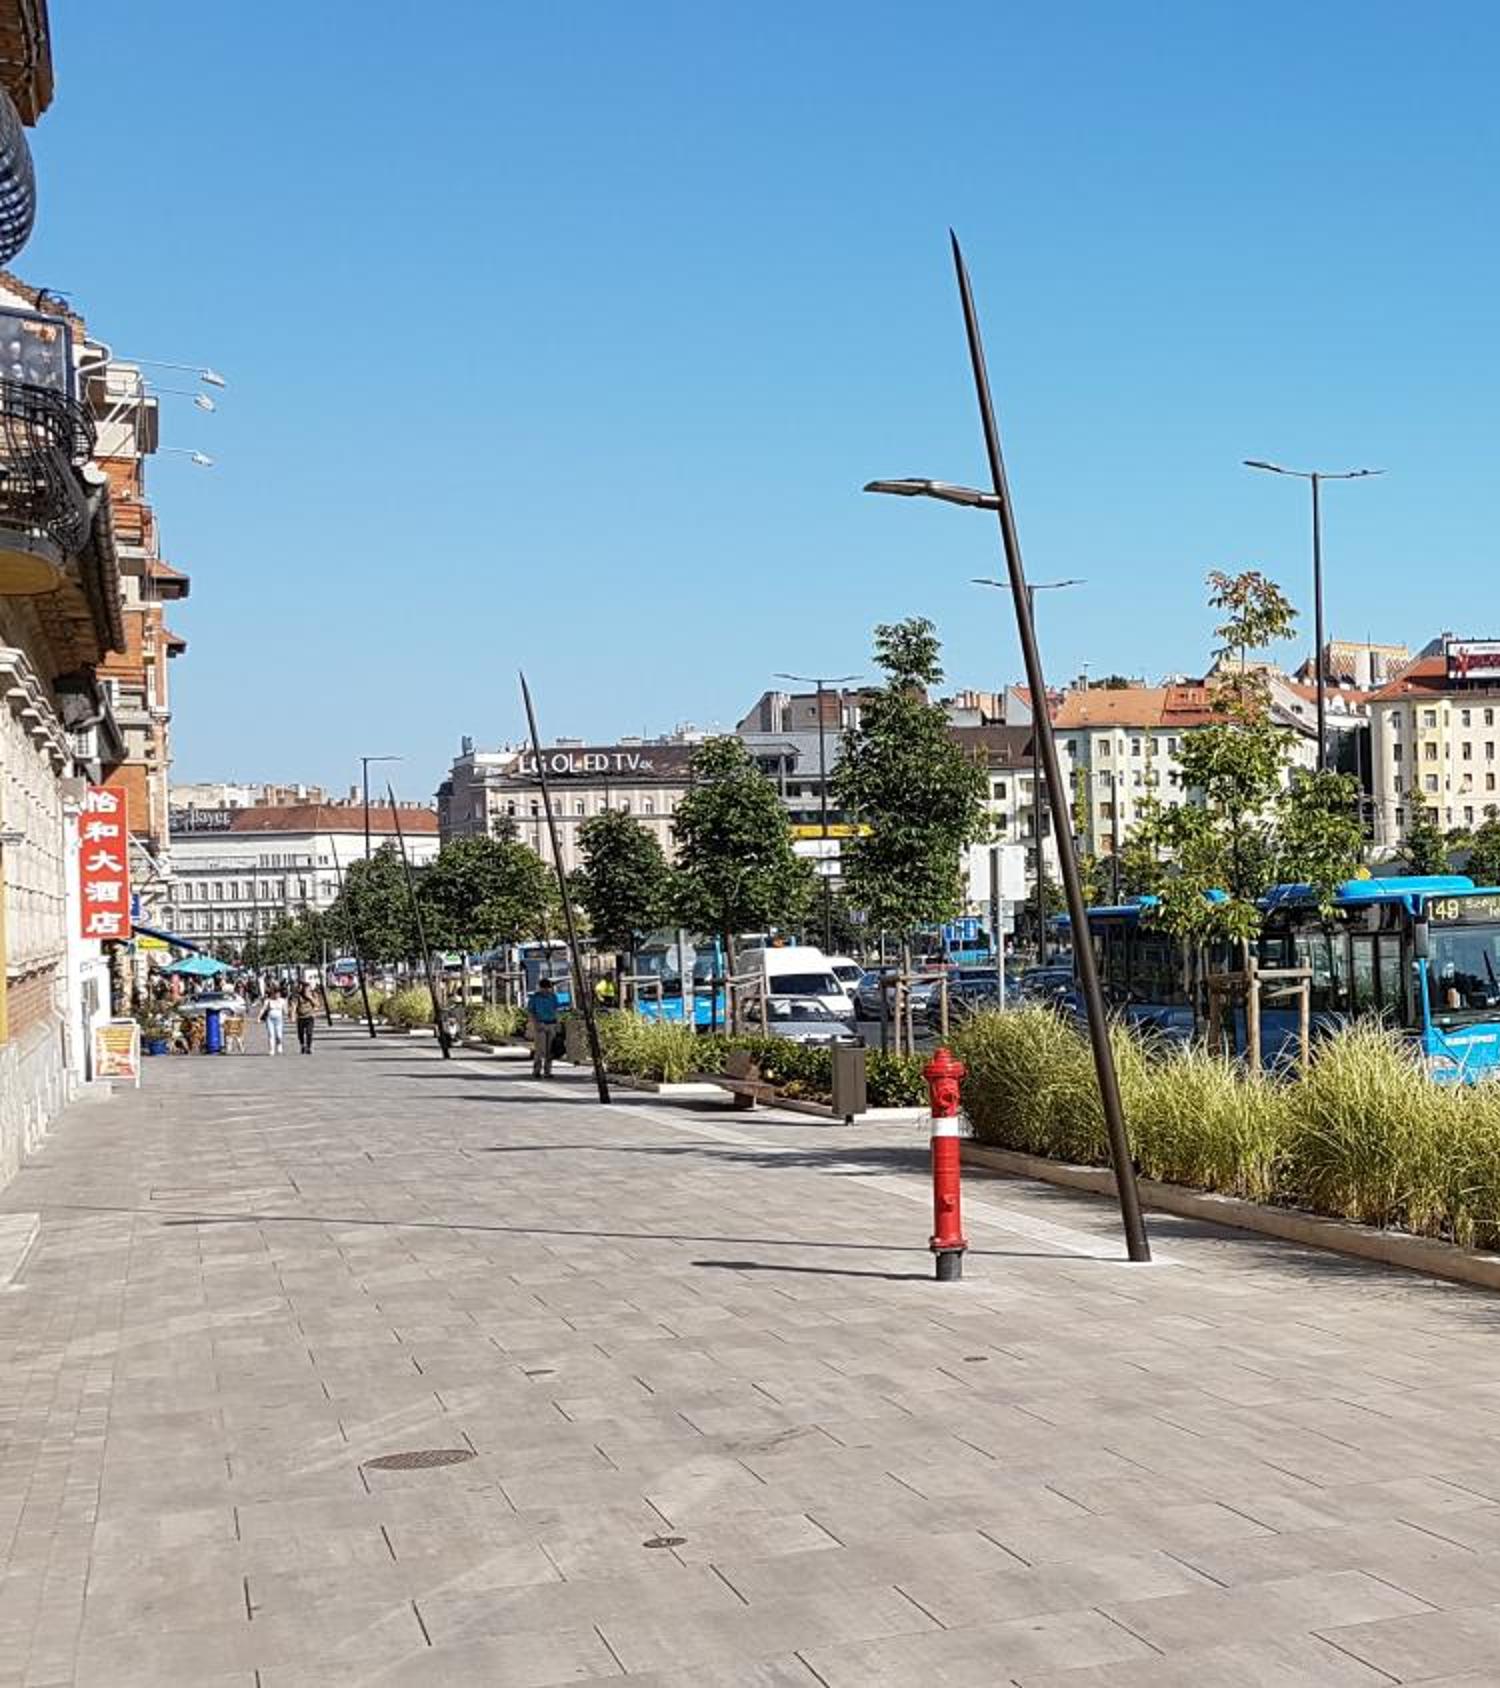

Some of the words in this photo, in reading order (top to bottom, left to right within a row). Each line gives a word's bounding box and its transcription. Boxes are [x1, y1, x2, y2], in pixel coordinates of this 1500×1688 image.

[518, 755, 547, 773] LG
[551, 752, 609, 773] OLED
[611, 752, 640, 771] TV
[1427, 899, 1460, 921] 149
